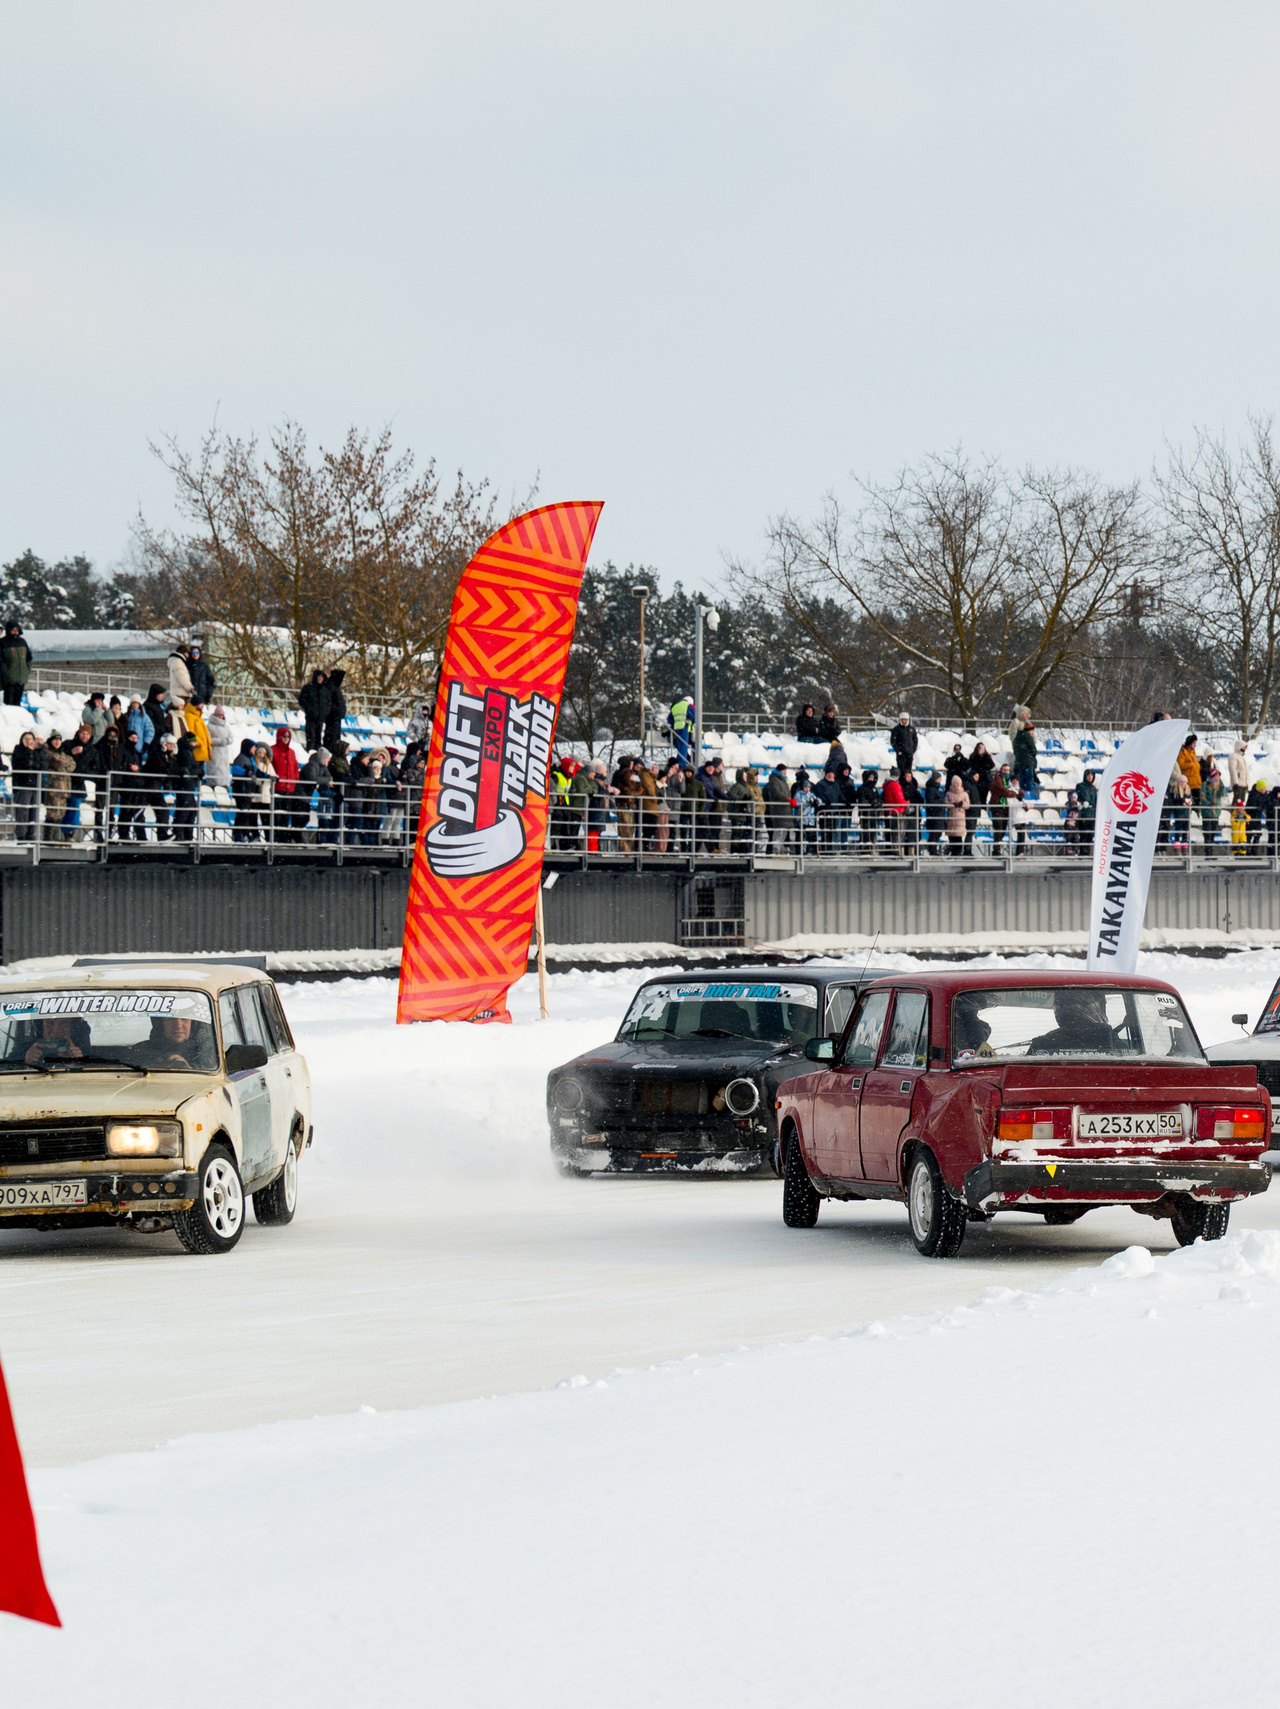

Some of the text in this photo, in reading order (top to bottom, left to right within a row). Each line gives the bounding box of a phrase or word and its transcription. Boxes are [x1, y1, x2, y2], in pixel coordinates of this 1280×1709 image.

[483, 706, 503, 762] EXPO
[527, 695, 556, 796] MODE
[440, 683, 485, 823] DRIFT
[1098, 819, 1112, 875] MOTOR OIL
[1096, 820, 1138, 958] TAKAYAMA
[703, 984, 782, 999] DRIFT TAXI
[1157, 997, 1175, 1005] RUS
[5, 1001, 40, 1011] DRIFT
[39, 995, 175, 1014] WINTER MODE
[625, 996, 664, 1023] 44
[1159, 1115, 1177, 1128] 50
[54, 1184, 80, 1198] 797
